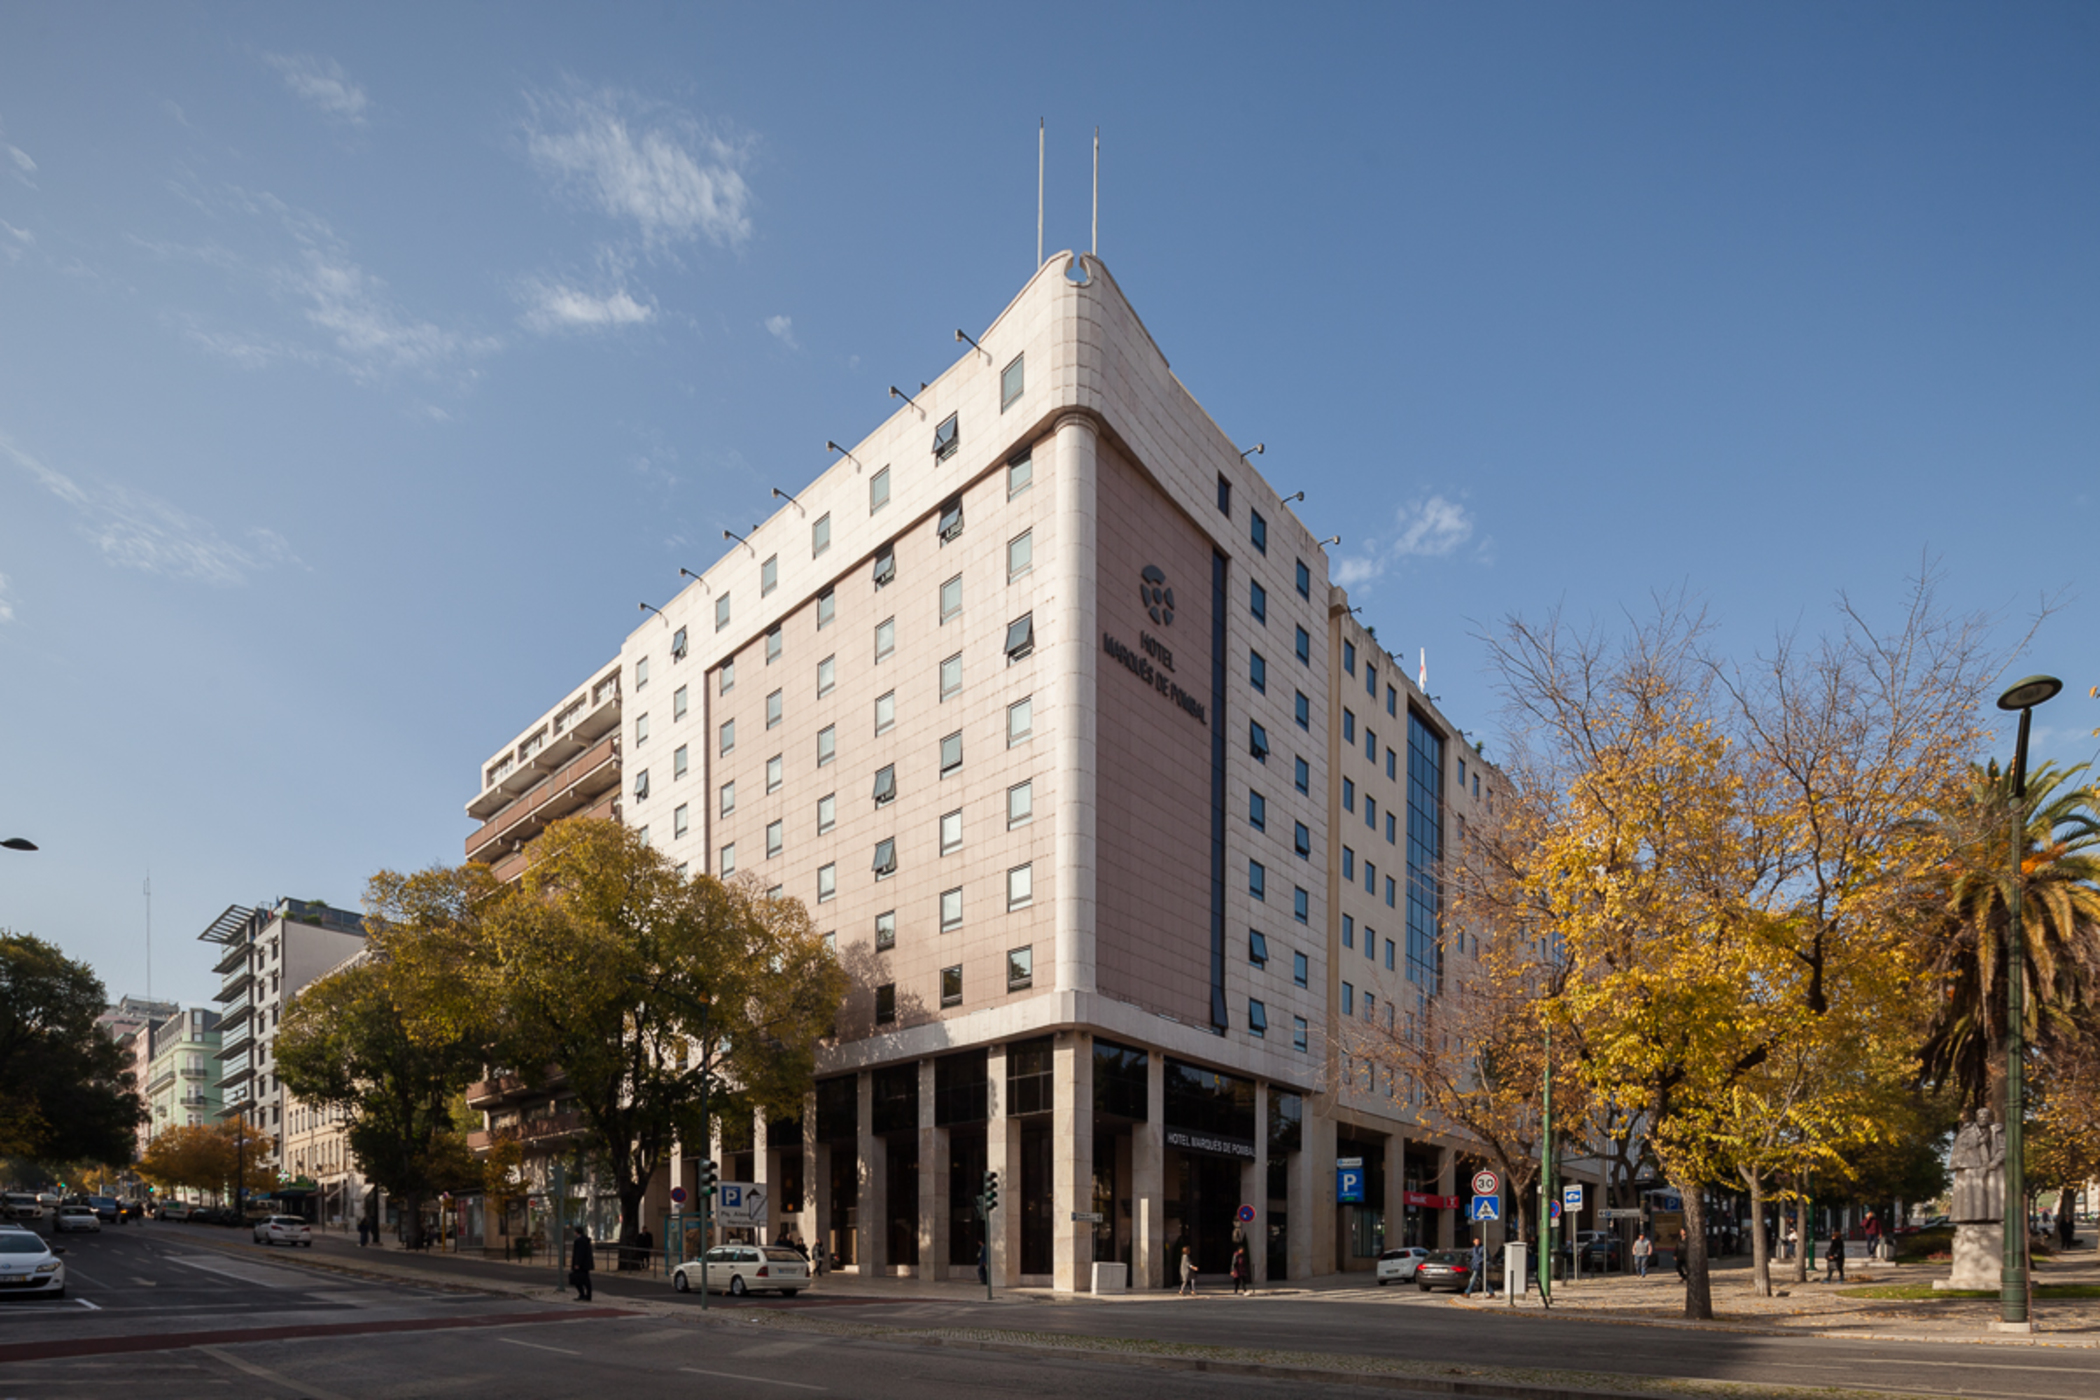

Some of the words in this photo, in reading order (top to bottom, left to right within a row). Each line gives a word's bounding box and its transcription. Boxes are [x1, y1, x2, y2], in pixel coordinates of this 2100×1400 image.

[1140, 630, 1176, 673] HOTEL
[1155, 671, 1169, 697] DE
[1170, 683, 1207, 725] POMBAL
[1168, 1132, 1190, 1146] HOTEL
[1223, 1142, 1231, 1154] DE
[1232, 1143, 1256, 1157] POMBAL
[1343, 1174, 1357, 1192] P
[1478, 1178, 1494, 1188] 30
[726, 1190, 737, 1205] P
[1667, 1198, 1677, 1208] P
